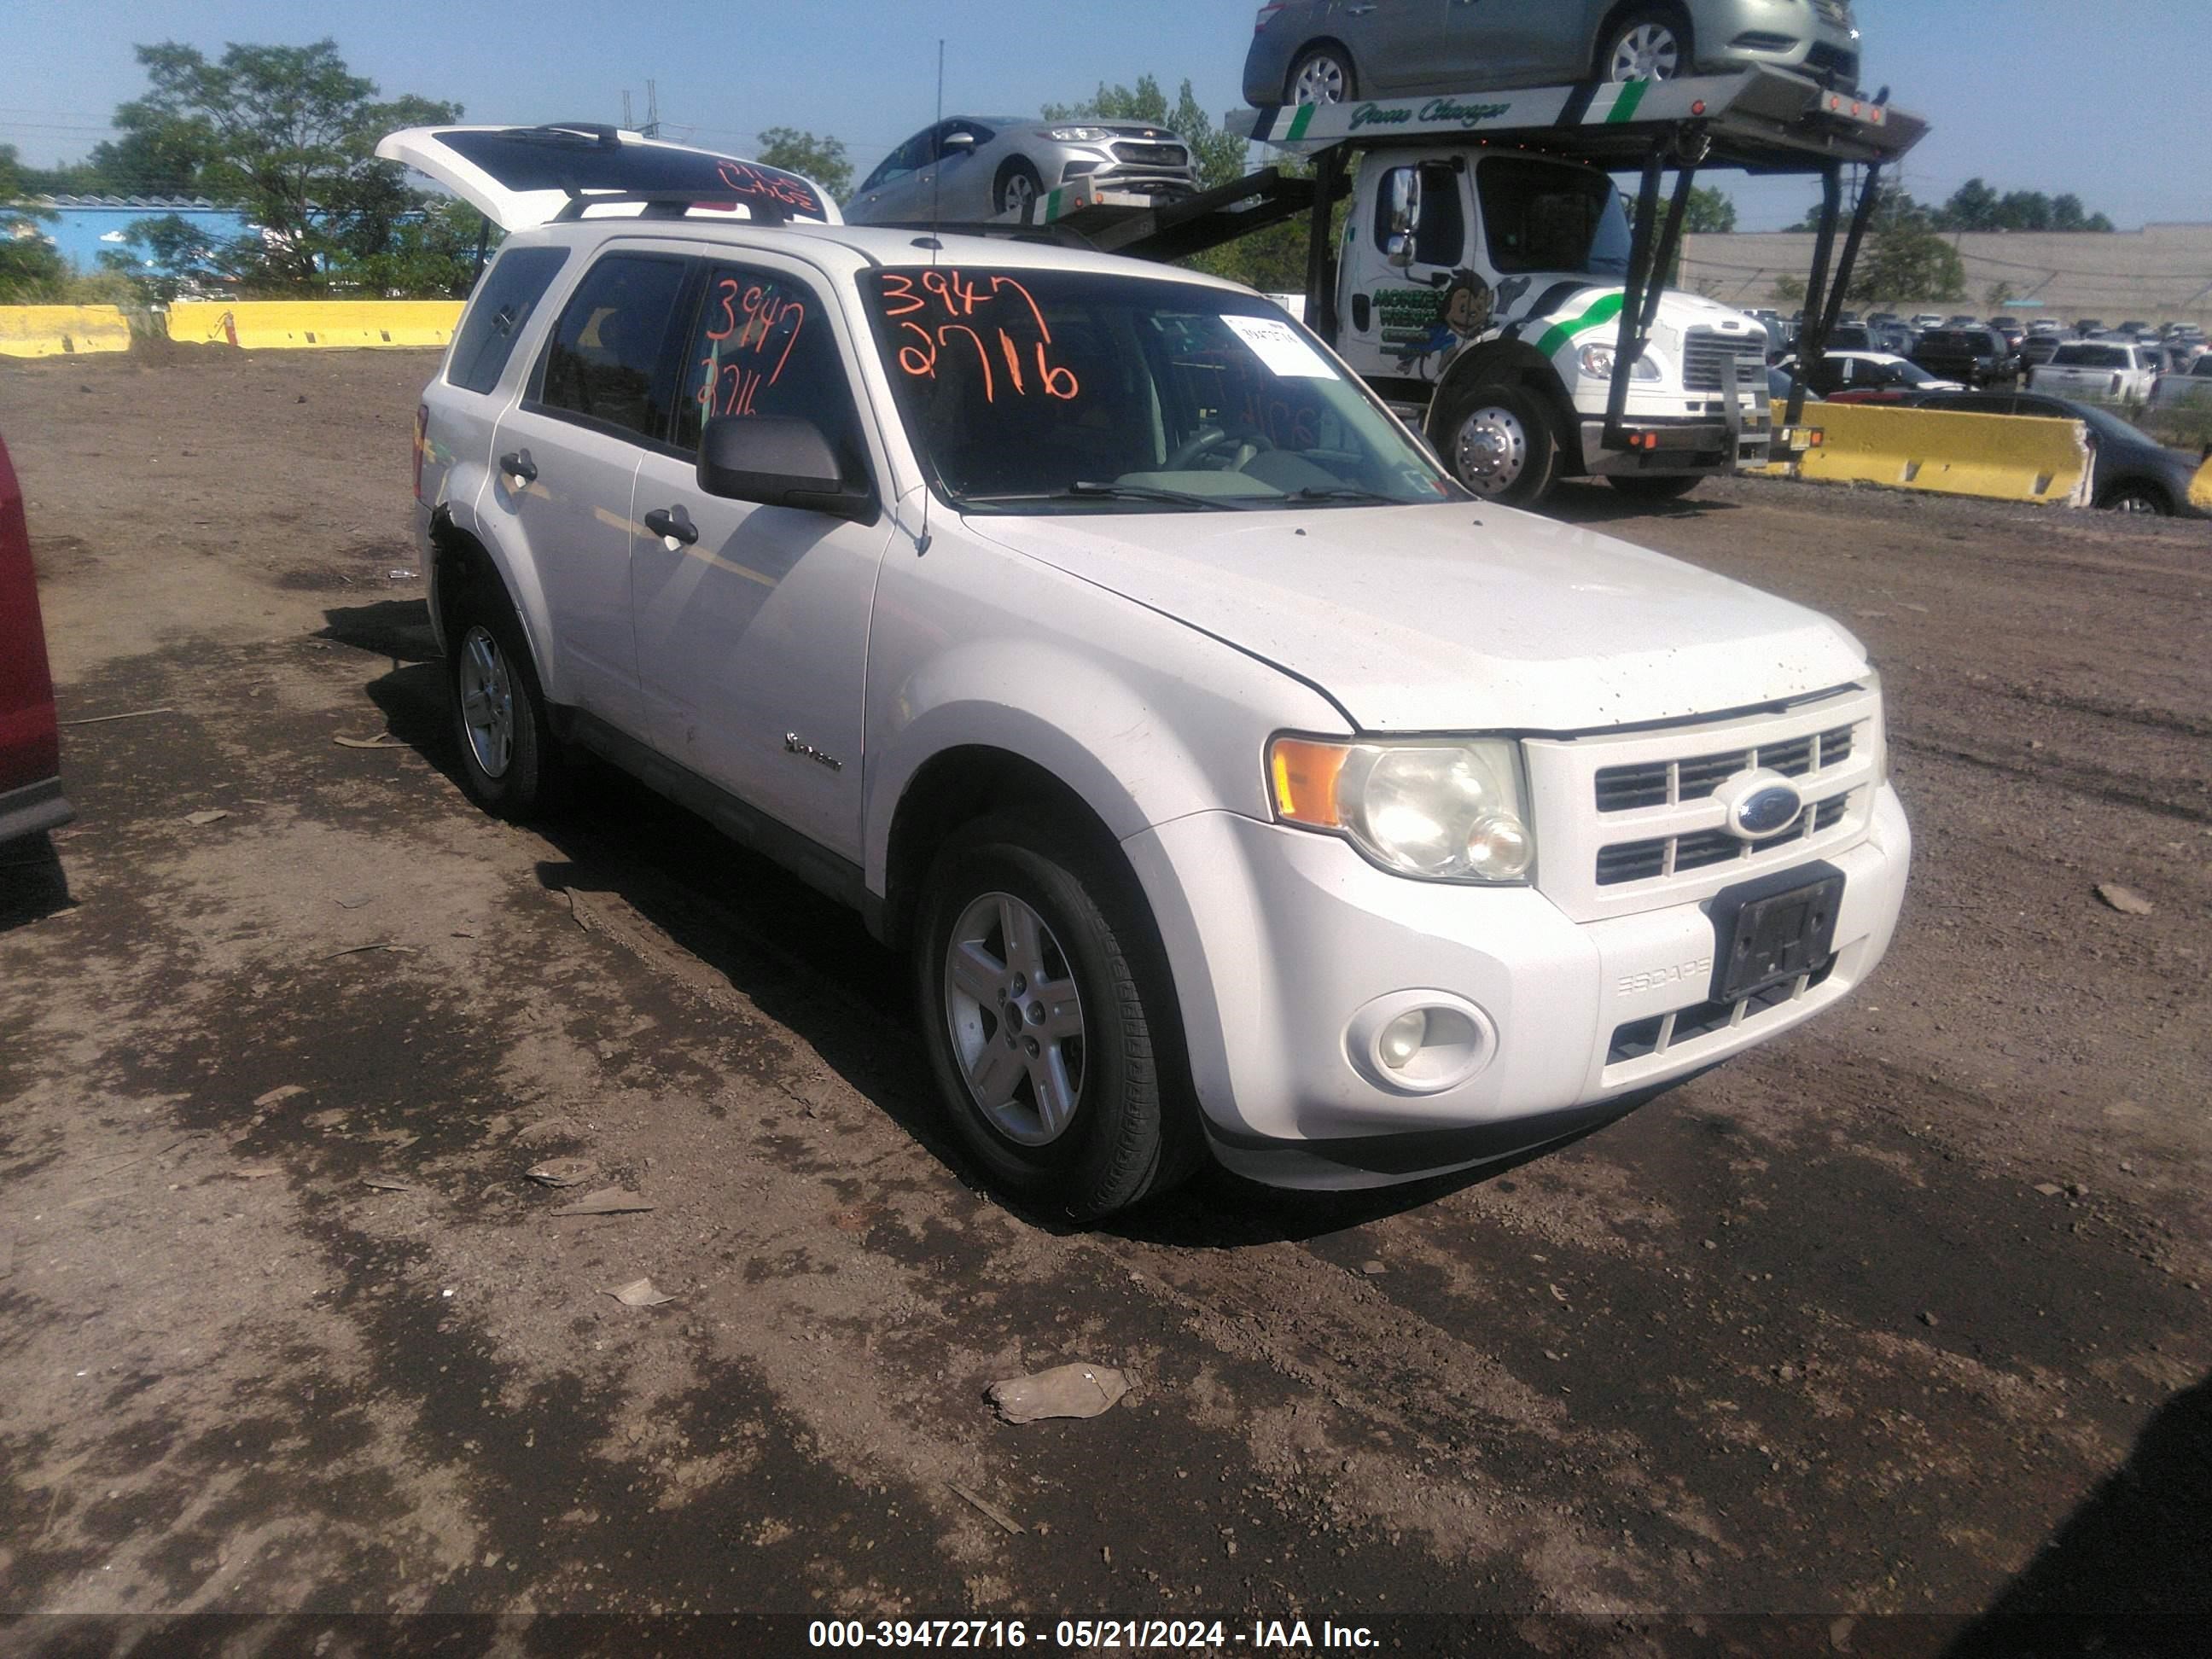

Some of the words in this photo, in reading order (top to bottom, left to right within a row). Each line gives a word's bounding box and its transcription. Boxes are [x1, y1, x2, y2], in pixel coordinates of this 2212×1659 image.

[706, 279, 805, 387] 3947
[882, 270, 1051, 345] 3947
[899, 322, 1080, 404] 2716
[1617, 956, 1711, 997] ESCAPE
